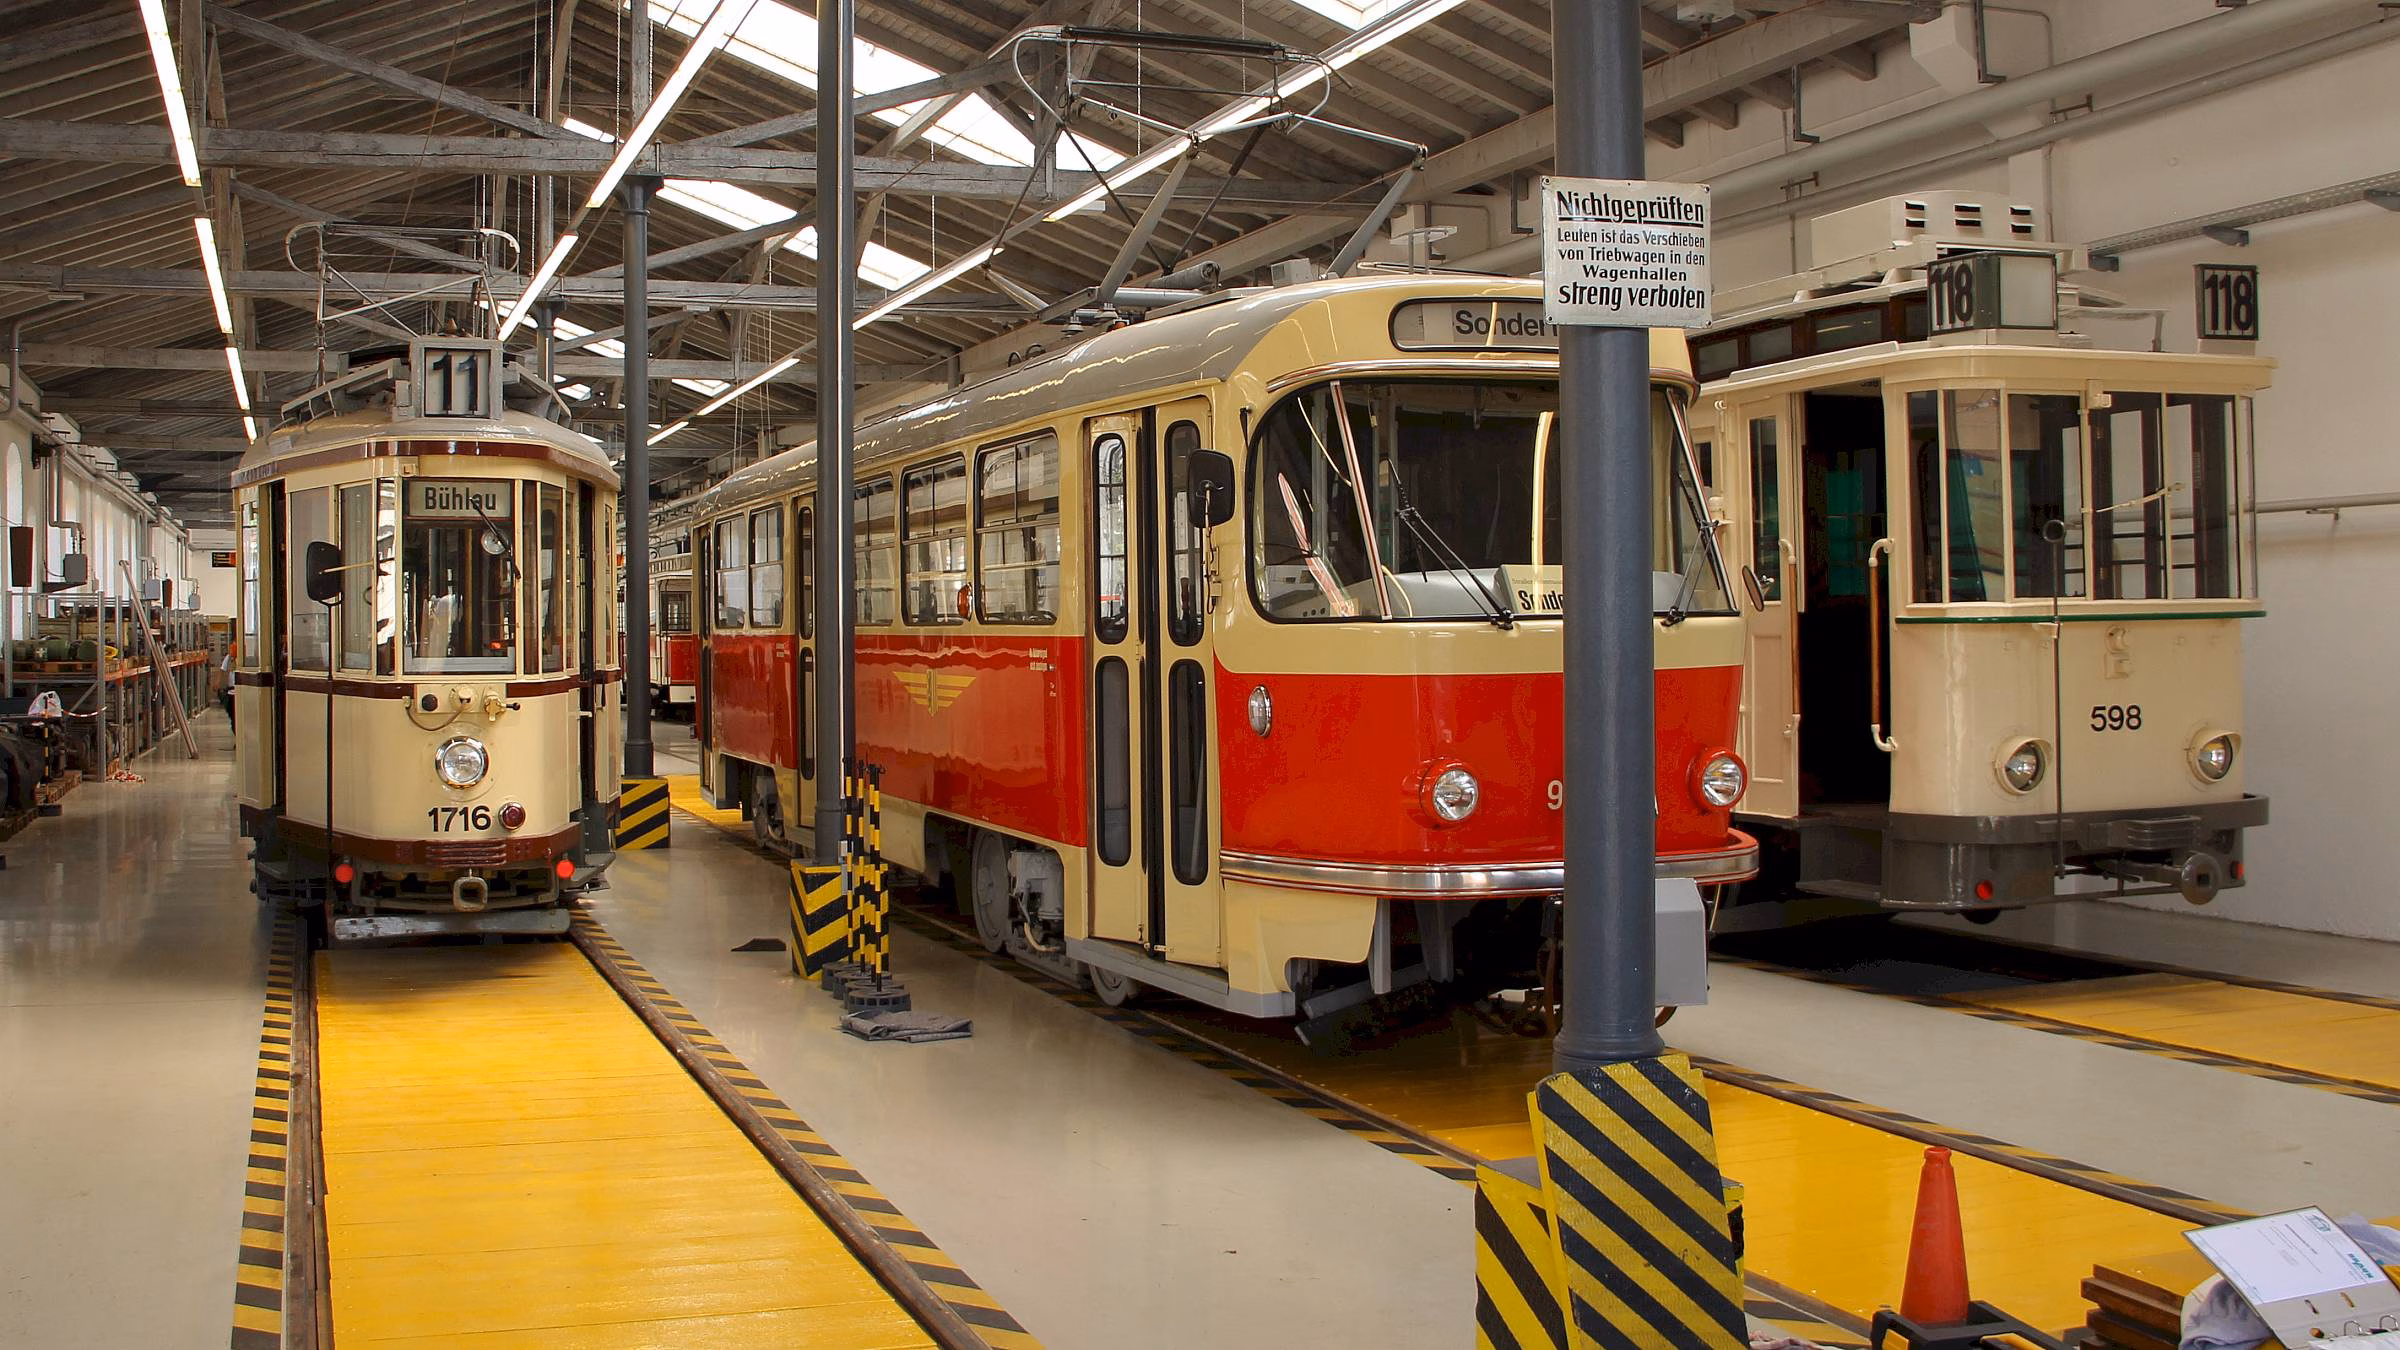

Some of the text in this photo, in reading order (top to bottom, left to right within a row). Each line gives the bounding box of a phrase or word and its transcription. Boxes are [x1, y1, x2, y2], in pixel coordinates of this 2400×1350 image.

[1556, 190, 1704, 224] Nichtgeprüften
[1557, 227, 1705, 248] Leuten ist das Verschieben
[1558, 246, 1705, 266] von Triebwagen in den
[1582, 264, 1687, 283] Wagenhallen
[1627, 284, 1705, 309] verboten
[1930, 262, 1973, 327] 118
[2204, 273, 2253, 331] 118
[432, 353, 478, 411] 11
[424, 486, 497, 511] Bühlau
[2090, 704, 2142, 732] 598
[428, 805, 492, 833] 1716
